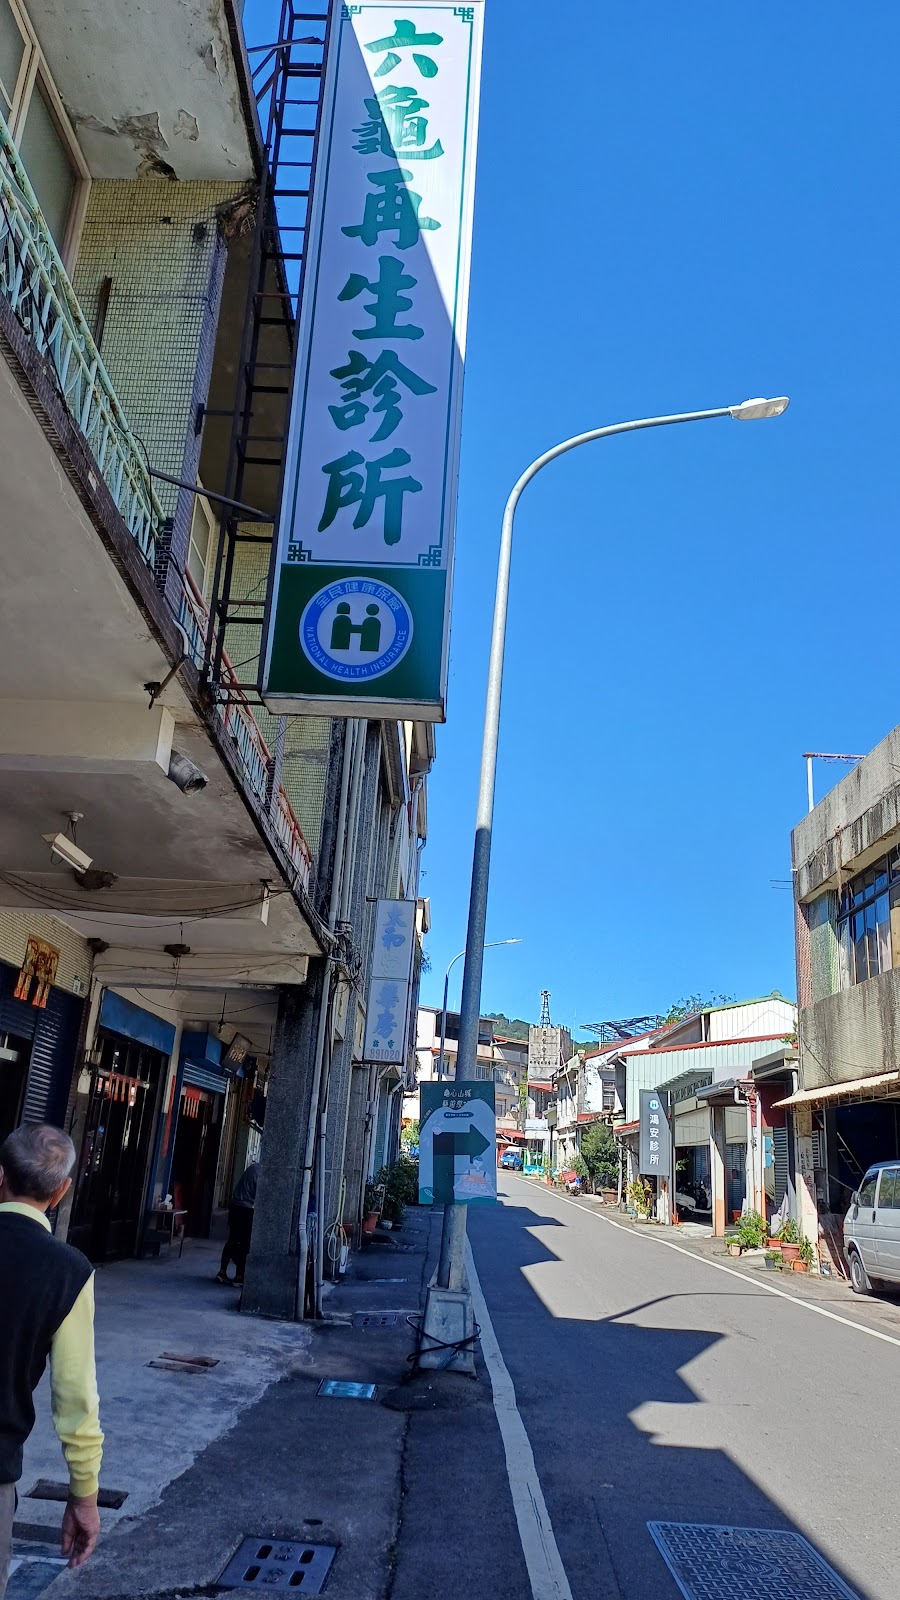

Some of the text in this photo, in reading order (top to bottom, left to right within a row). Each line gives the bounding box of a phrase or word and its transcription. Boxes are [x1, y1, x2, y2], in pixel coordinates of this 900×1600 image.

[317, 19, 445, 547] 六龜再生診所
[315, 581, 402, 612] 全民健康保險
[306, 626, 407, 676] NATIONAL HEALTH INSURANCE
[364, 1048, 400, 1061] 891020
[649, 1114, 660, 1166] 鴻安診所
